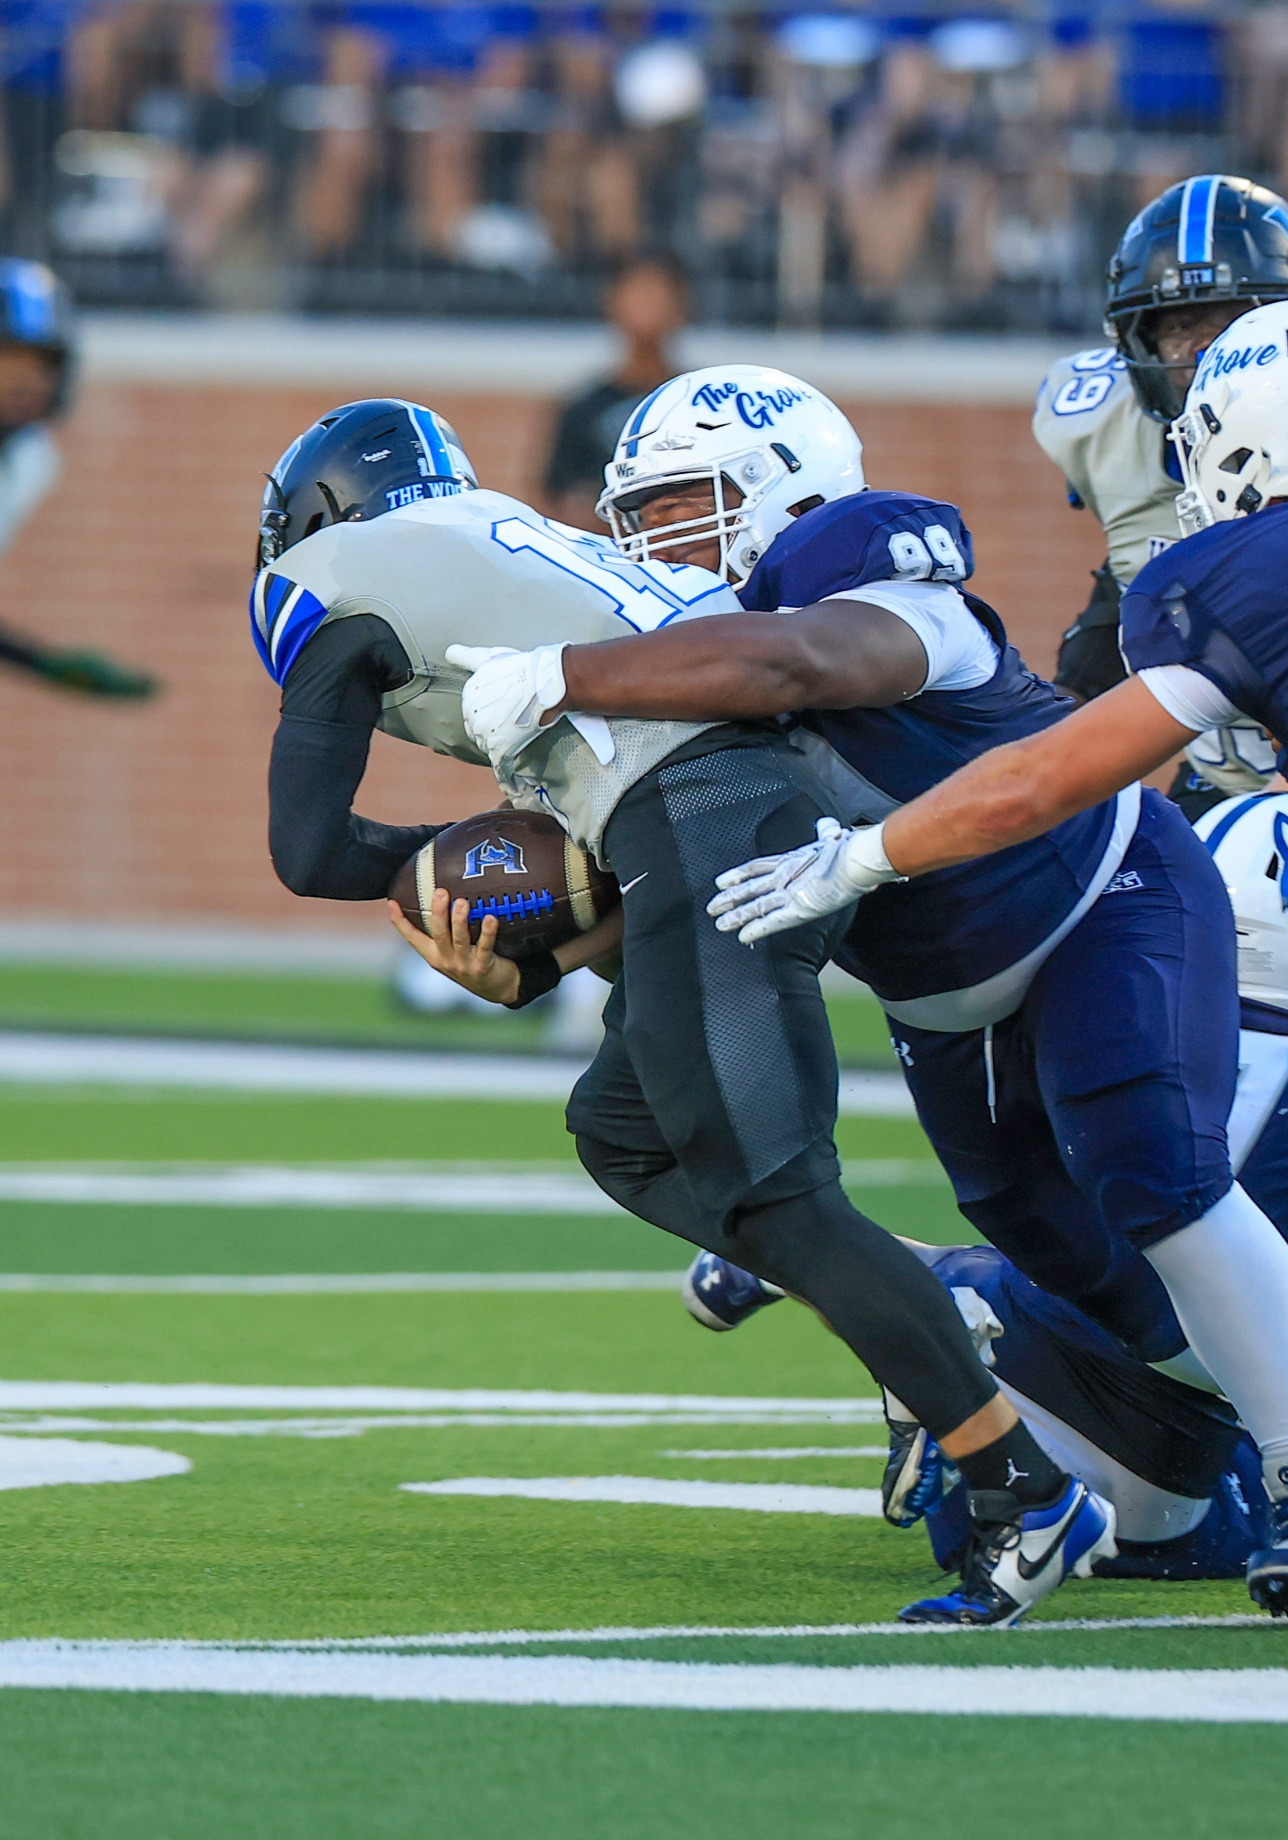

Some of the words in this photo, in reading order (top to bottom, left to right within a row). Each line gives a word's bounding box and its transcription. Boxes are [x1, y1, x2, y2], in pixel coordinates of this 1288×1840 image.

[691, 382, 738, 412] The
[385, 482, 424, 510] THE
[887, 523, 967, 581] 99
